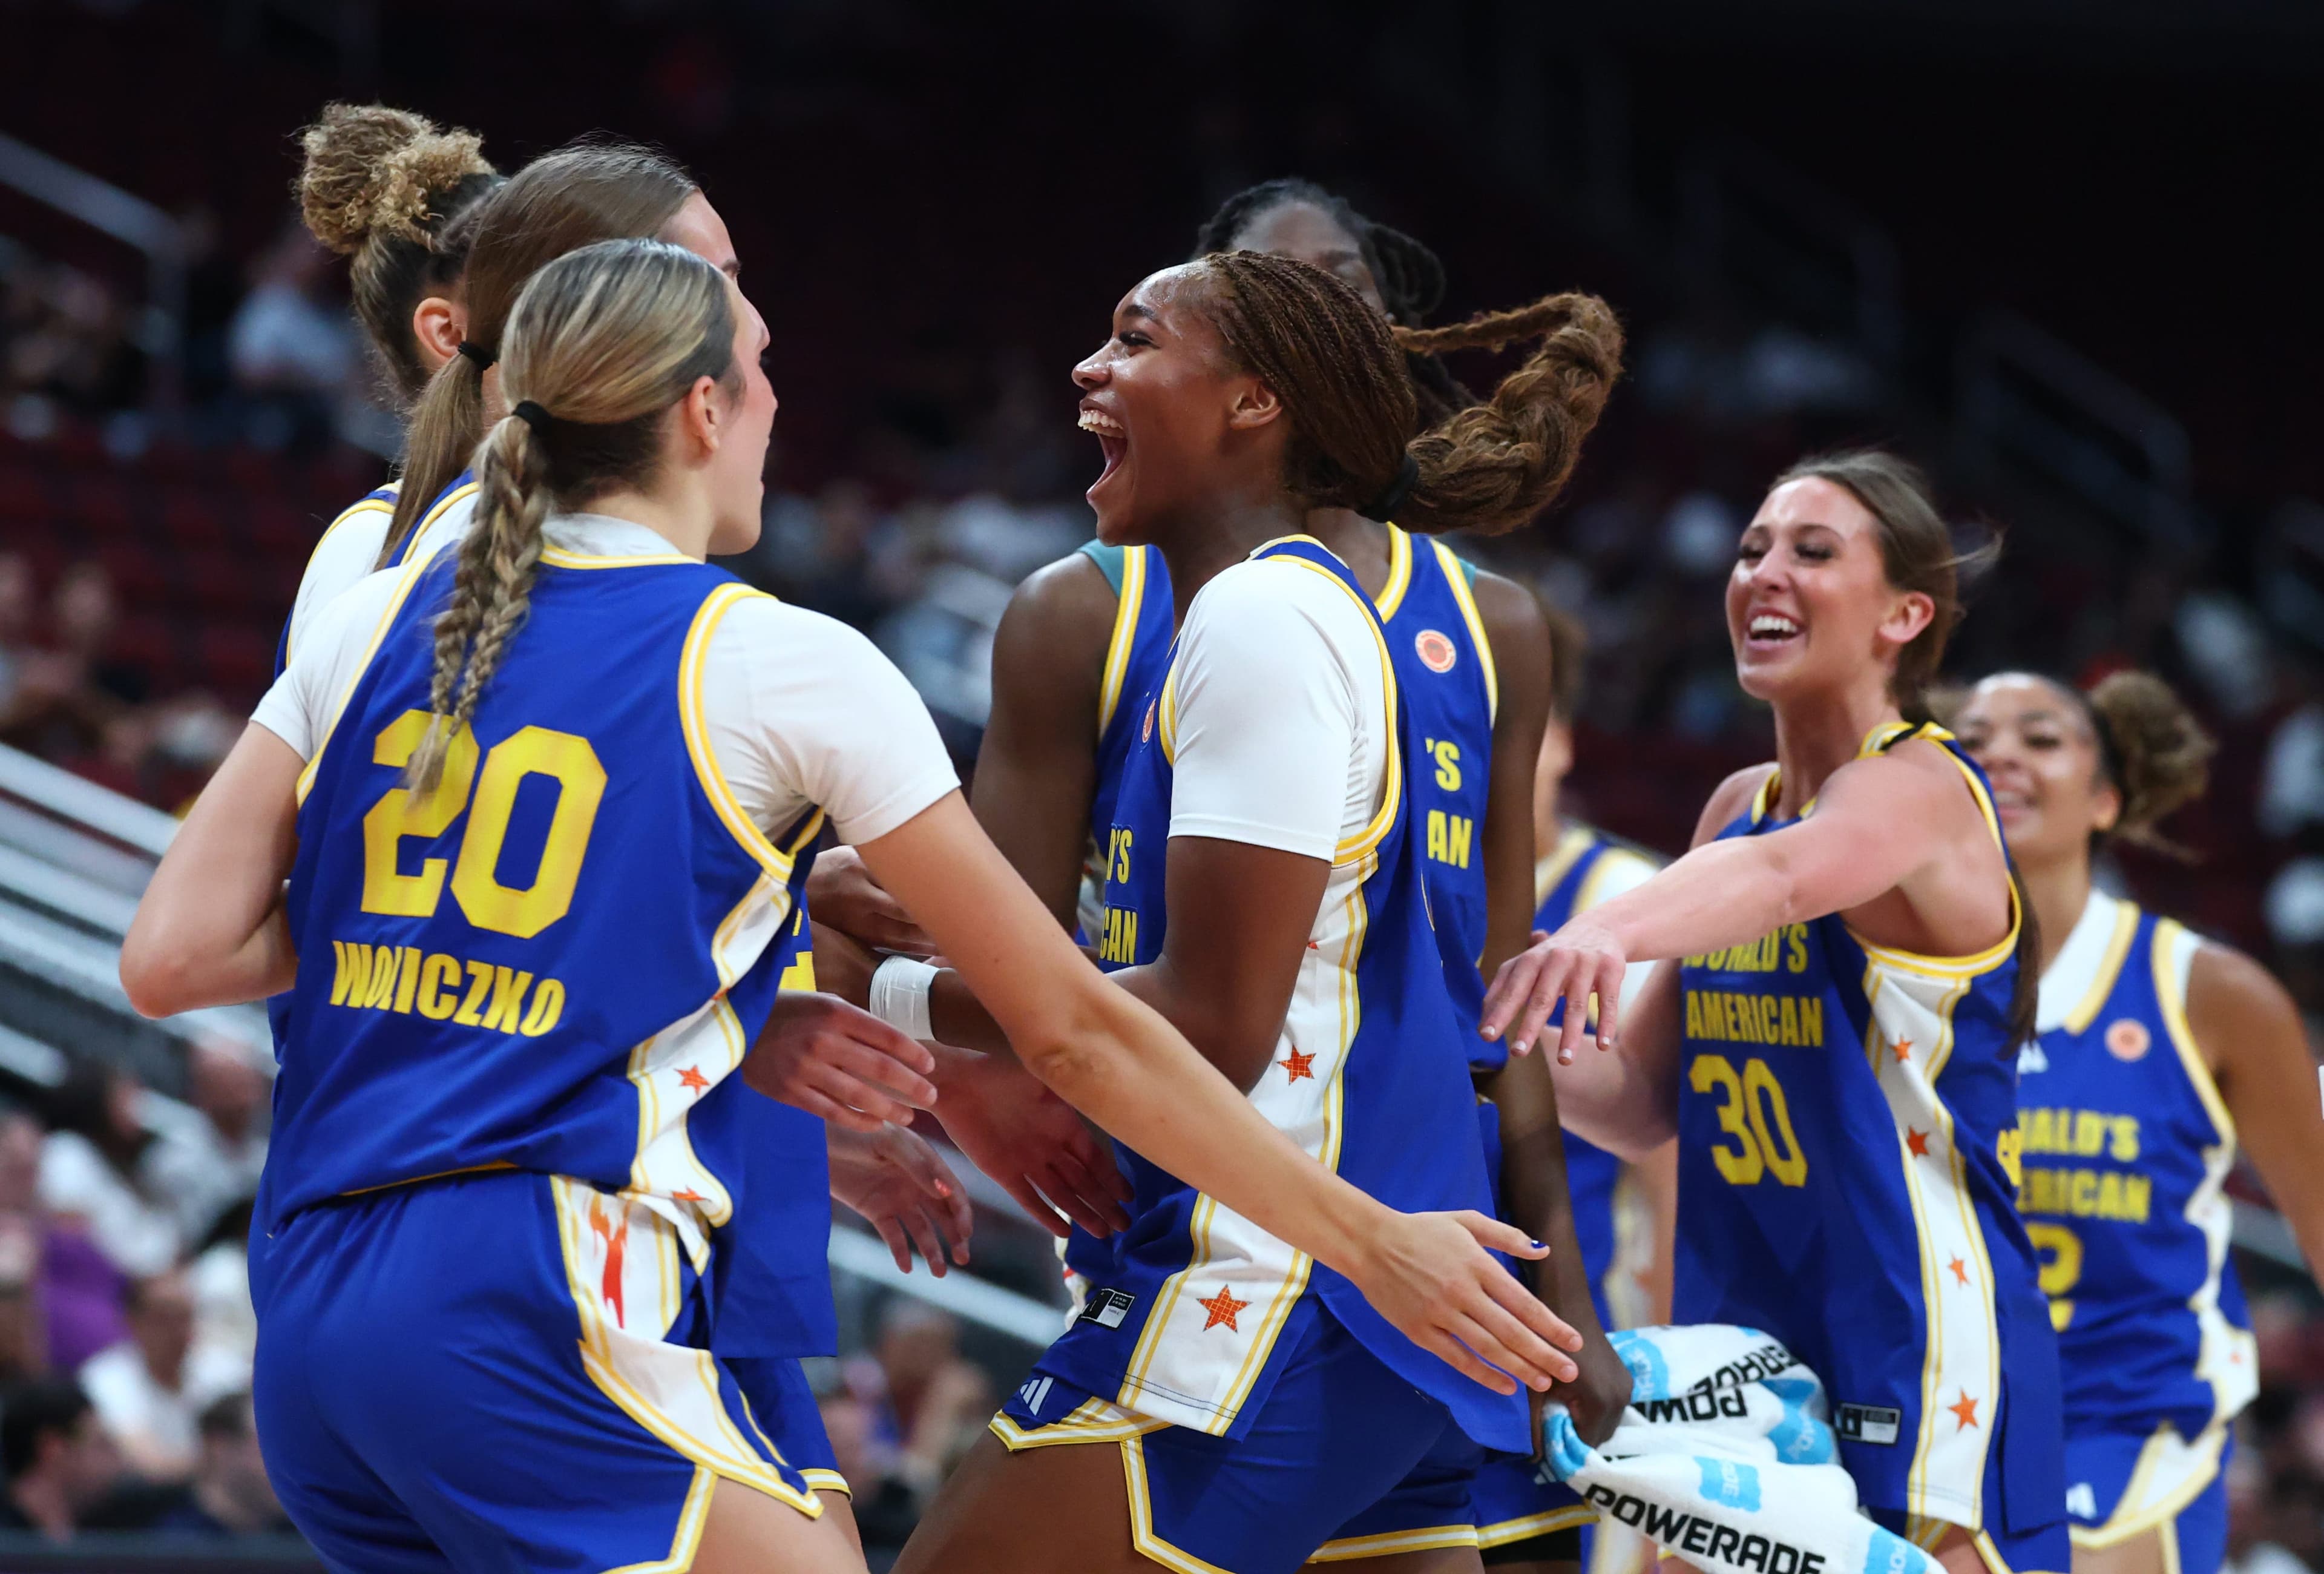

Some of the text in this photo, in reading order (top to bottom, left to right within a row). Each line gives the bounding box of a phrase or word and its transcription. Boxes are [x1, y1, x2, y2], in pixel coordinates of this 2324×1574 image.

[361, 709, 608, 939] 20
[1428, 809, 1472, 869] AN
[1100, 906, 1137, 964] CAN
[1686, 990, 1822, 1046] AMERICAN
[1688, 1055, 1808, 1187] 30
[1630, 1389, 1747, 1423] POW
[1585, 1483, 1825, 1574] POWERADE
